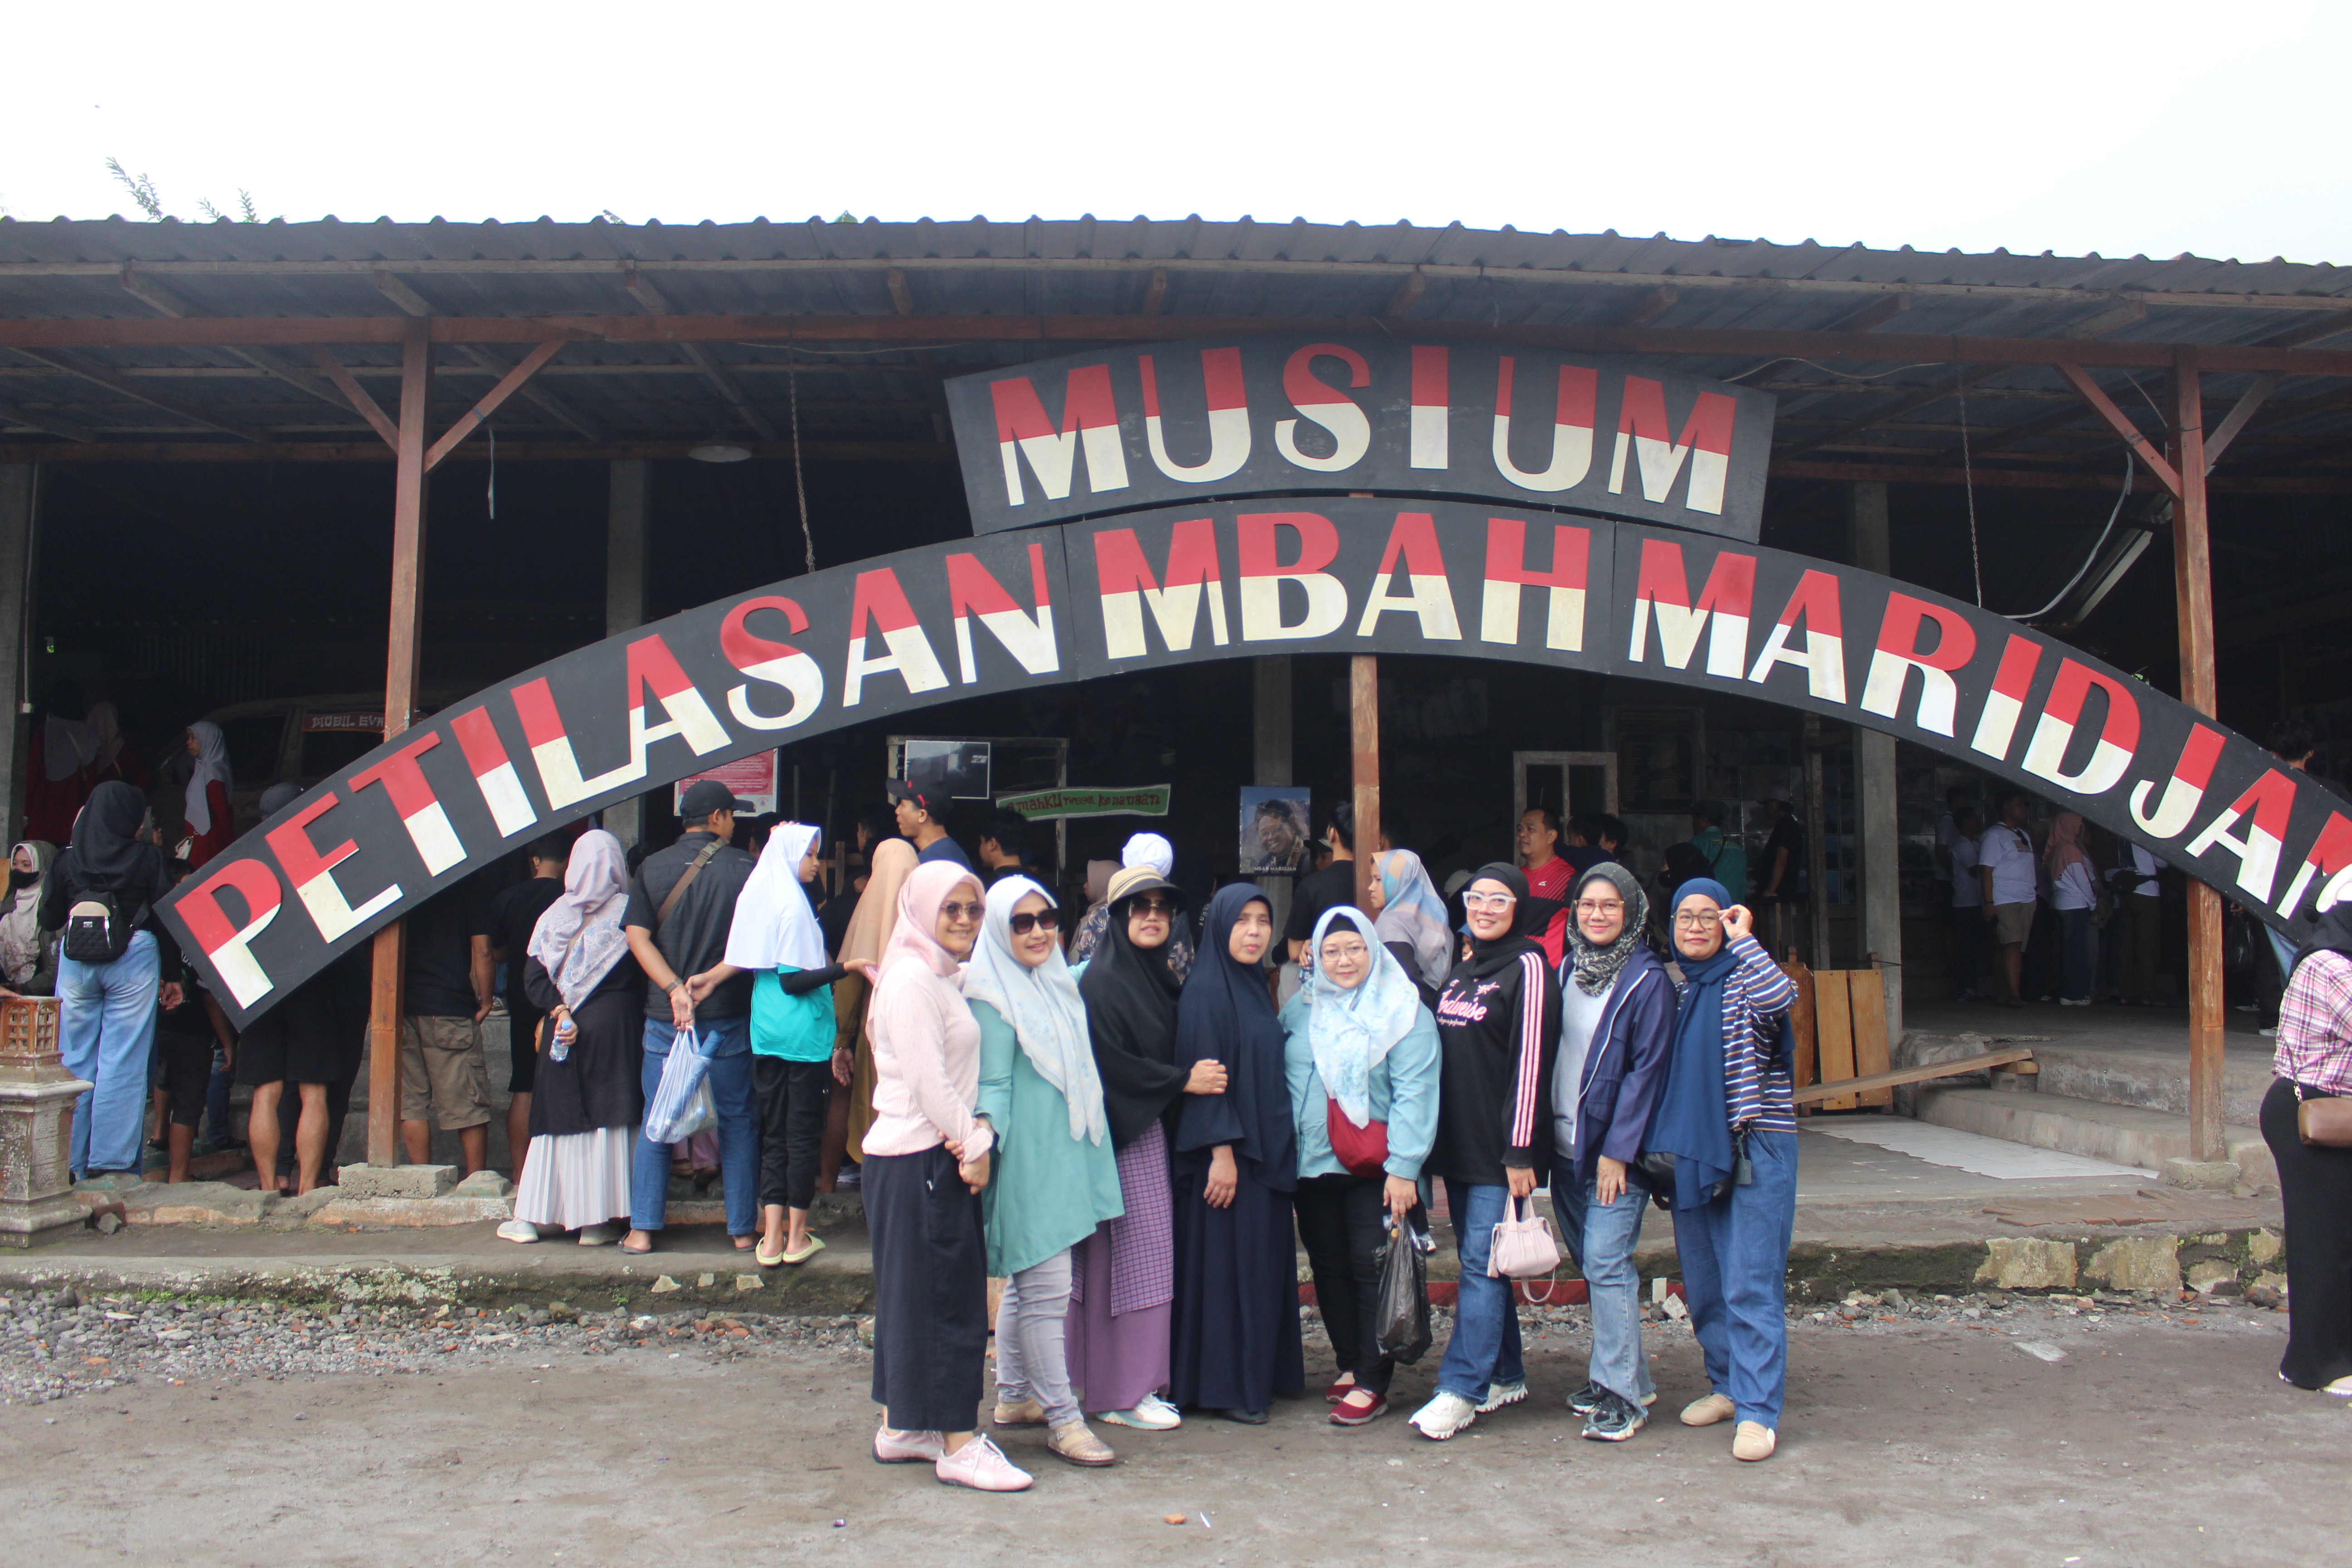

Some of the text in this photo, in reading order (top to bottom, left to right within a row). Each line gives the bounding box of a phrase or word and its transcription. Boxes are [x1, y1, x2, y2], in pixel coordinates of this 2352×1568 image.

[990, 343, 1735, 516] MUSIUM
[173, 543, 1060, 1010] PETILASAN
[1093, 511, 1590, 659] MBAH
[312, 715, 355, 728] MOBIL
